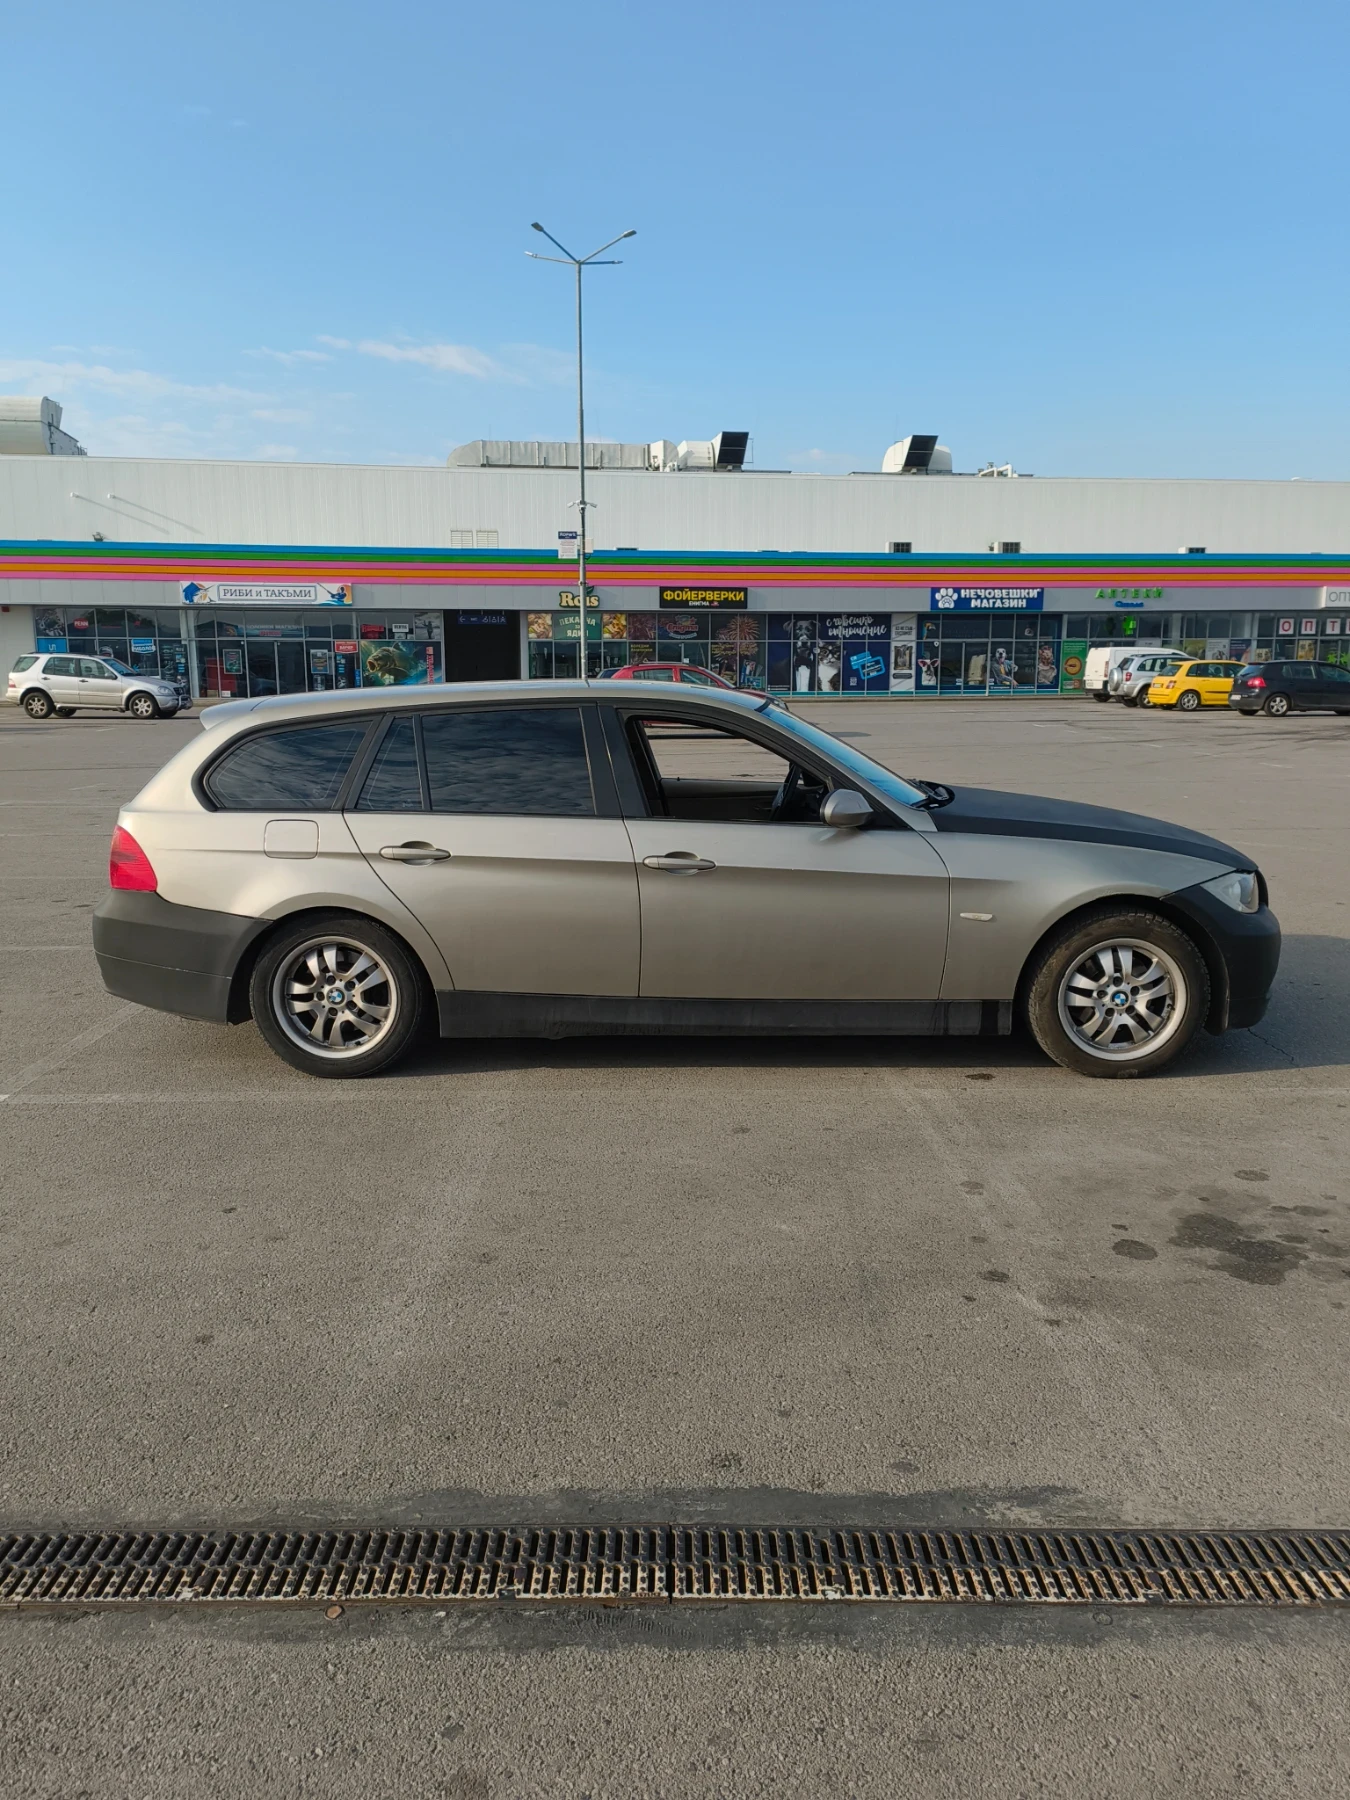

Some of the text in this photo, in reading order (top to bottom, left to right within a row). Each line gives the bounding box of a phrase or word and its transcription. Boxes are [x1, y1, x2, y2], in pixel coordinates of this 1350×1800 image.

[223, 588, 253, 597] РИБИ
[264, 589, 312, 598] ТАКЪМИ
[663, 588, 745, 601] ФОЙЕРВЕРКИ
[1095, 588, 1163, 599] АПТЕКИ
[970, 599, 1027, 608] МАГАЗИН
[559, 616, 596, 626] ПЕКАНА
[828, 625, 887, 637] отношение
